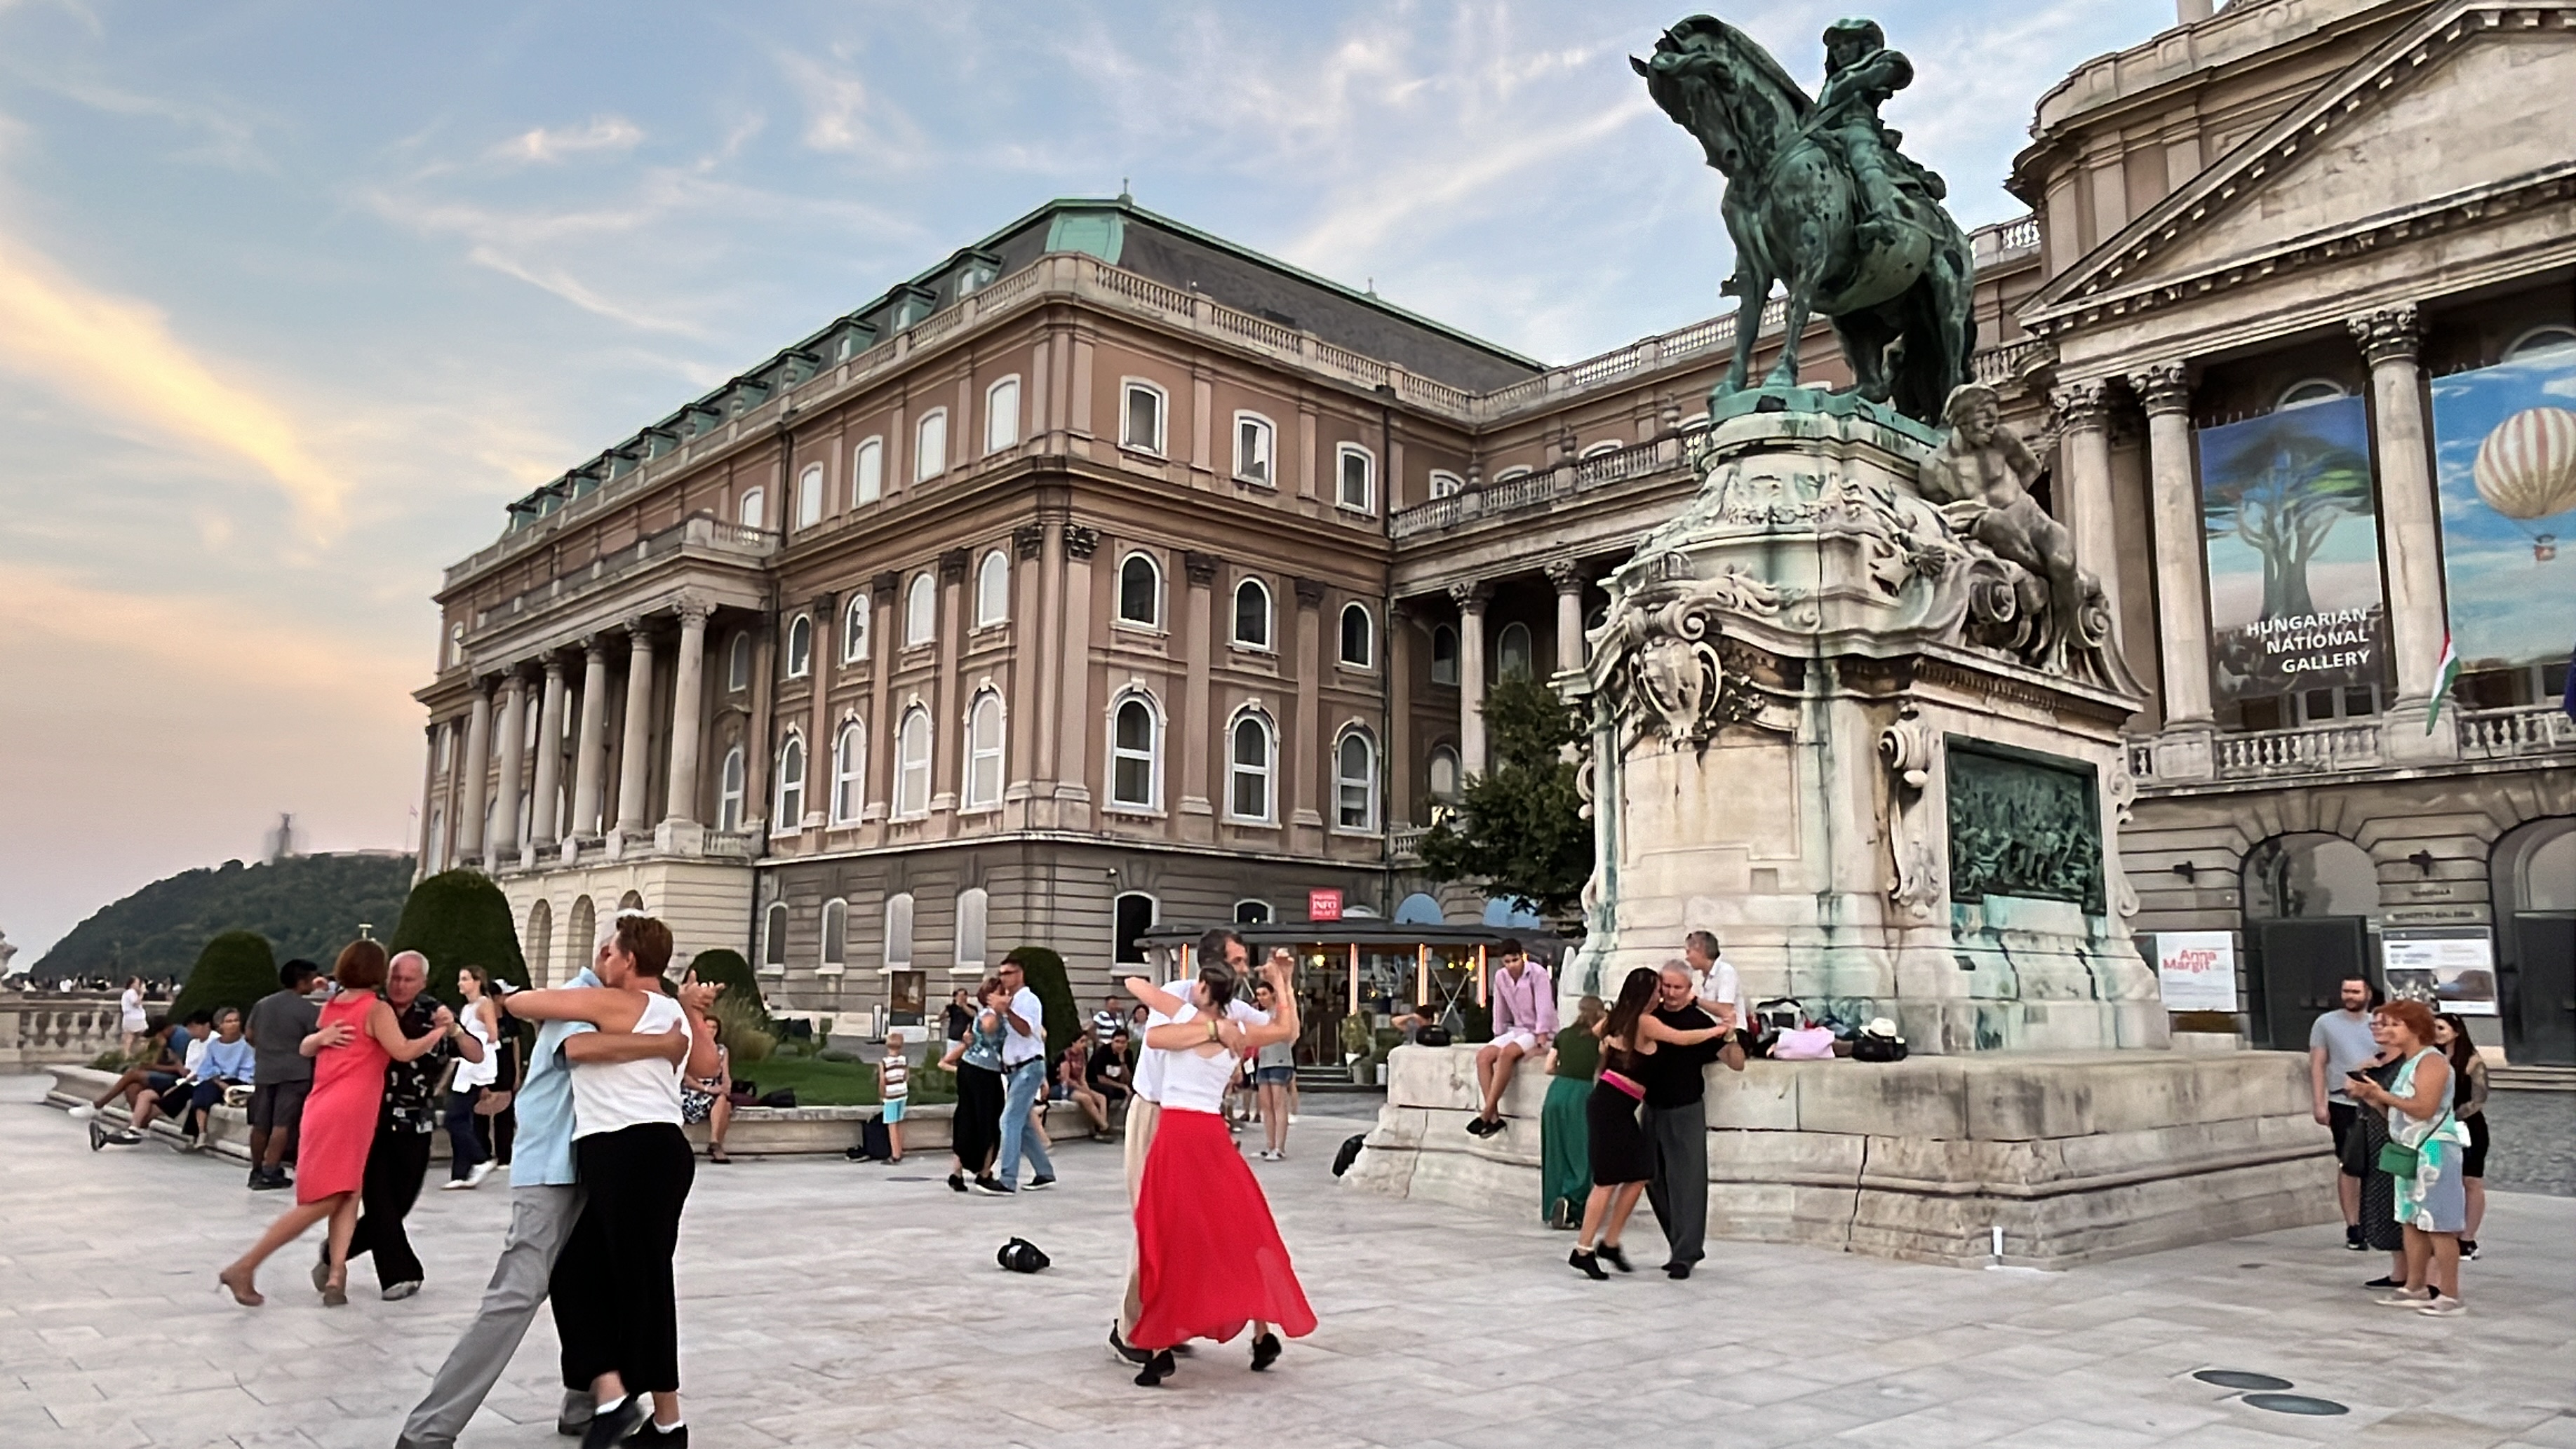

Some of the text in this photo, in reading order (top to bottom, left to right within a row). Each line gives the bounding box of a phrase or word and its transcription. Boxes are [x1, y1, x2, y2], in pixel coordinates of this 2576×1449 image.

[2246, 608, 2367, 636] HUNGARIAN
[2267, 628, 2369, 654] NATIONAL
[2281, 649, 2370, 673] GALLERY
[1313, 901, 1337, 910] INFO
[2180, 949, 2217, 961] Anna
[2163, 958, 2211, 973] Margit
